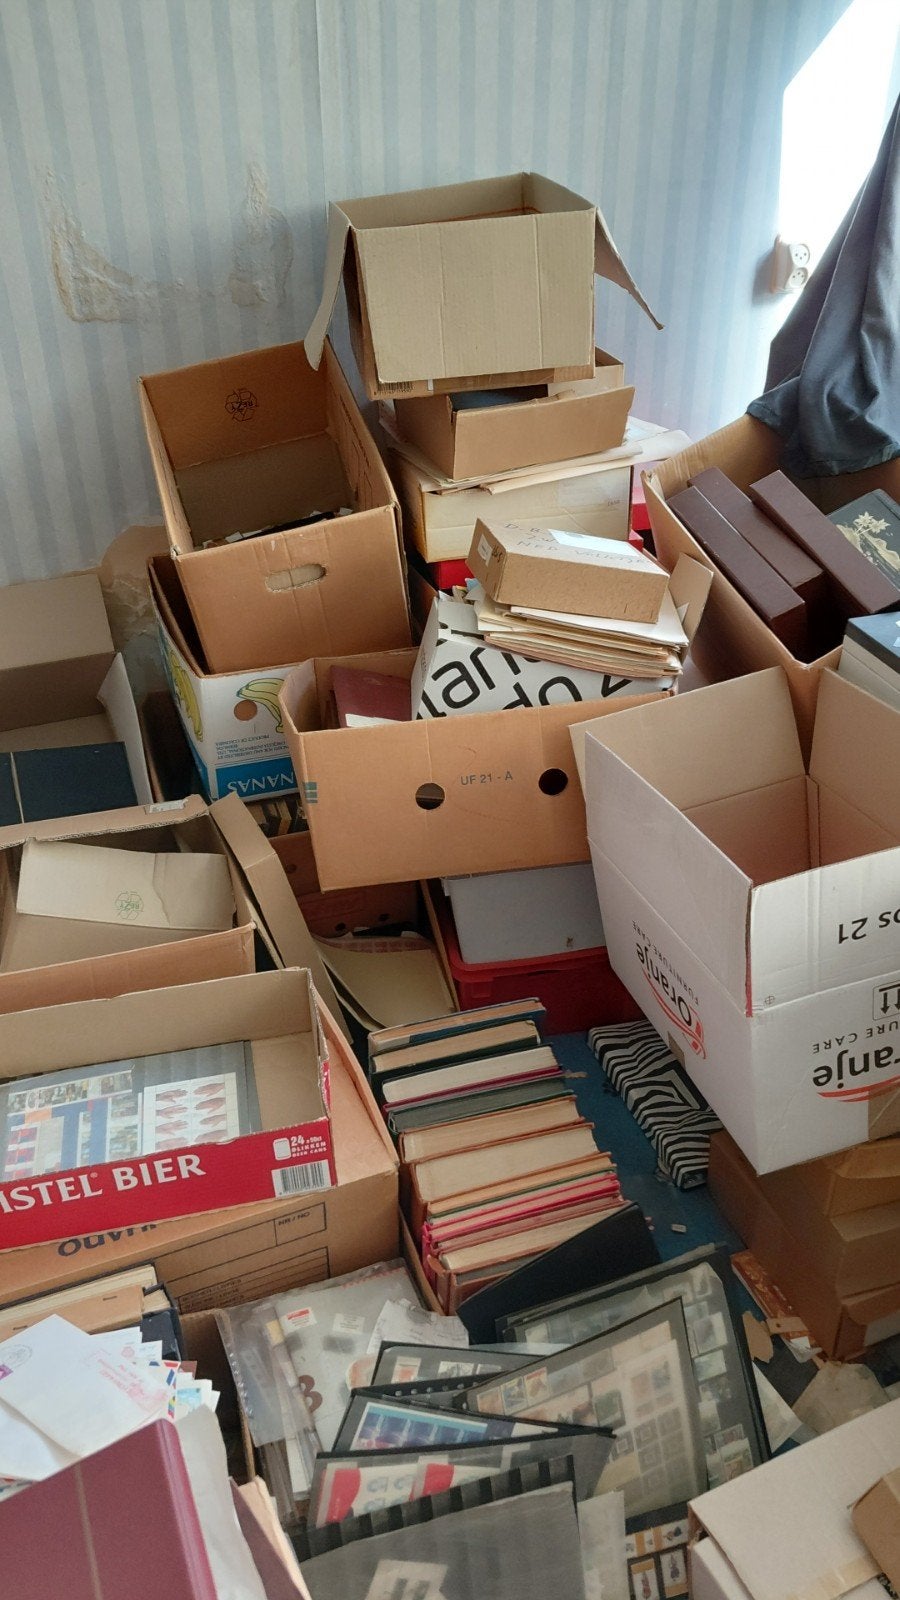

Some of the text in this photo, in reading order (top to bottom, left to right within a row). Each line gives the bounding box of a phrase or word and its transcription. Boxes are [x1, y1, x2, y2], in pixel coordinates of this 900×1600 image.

[460, 774, 476, 785] UF
[480, 773, 492, 784] 21
[505, 771, 513, 781] A
[839, 917, 868, 944] 21
[636, 942, 692, 1027] Oranje
[812, 1033, 858, 1054] CARE
[290, 1135, 305, 1147] 24
[112, 1154, 206, 1191] BIER
